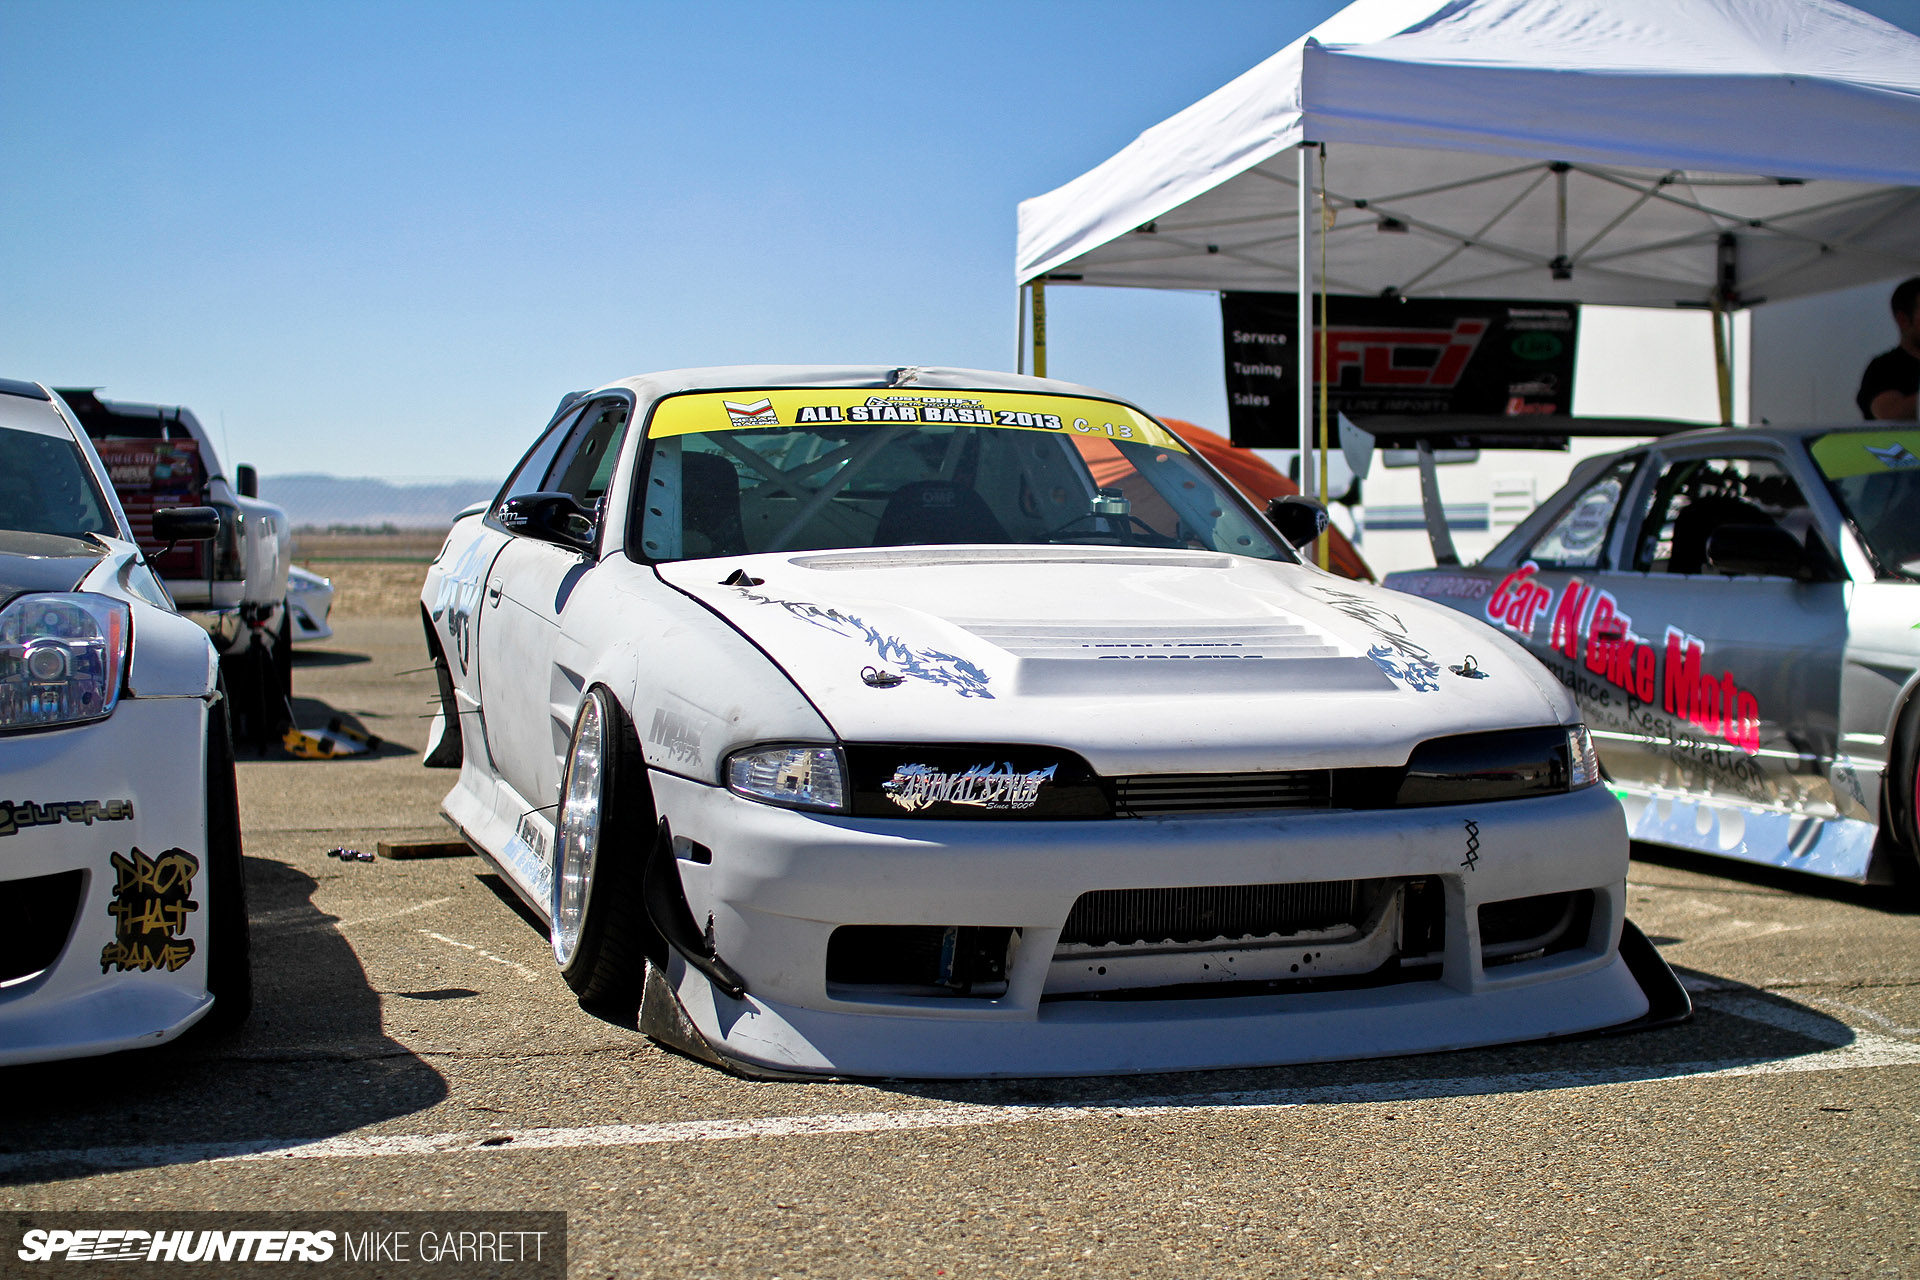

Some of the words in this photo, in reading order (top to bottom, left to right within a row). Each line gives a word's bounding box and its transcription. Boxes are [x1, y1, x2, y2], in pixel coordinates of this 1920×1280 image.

[1232, 330, 1287, 345] Service
[1234, 362, 1283, 379] Tuning
[1234, 393, 1271, 407] Sales
[798, 406, 845, 424] ALL
[849, 406, 918, 423] STAR
[921, 406, 995, 425] BASH
[998, 409, 1063, 429] 2013
[1486, 561, 1553, 639] Car
[1550, 576, 1594, 660] N
[1585, 590, 1656, 704] Bike
[1663, 623, 1761, 757] Moto
[899, 773, 979, 802] ANIMAL
[977, 773, 1042, 802] STYLE
[986, 801, 1010, 810] Since
[110, 849, 199, 896] DROP
[108, 898, 197, 936] THAT
[101, 941, 193, 974] FRAME
